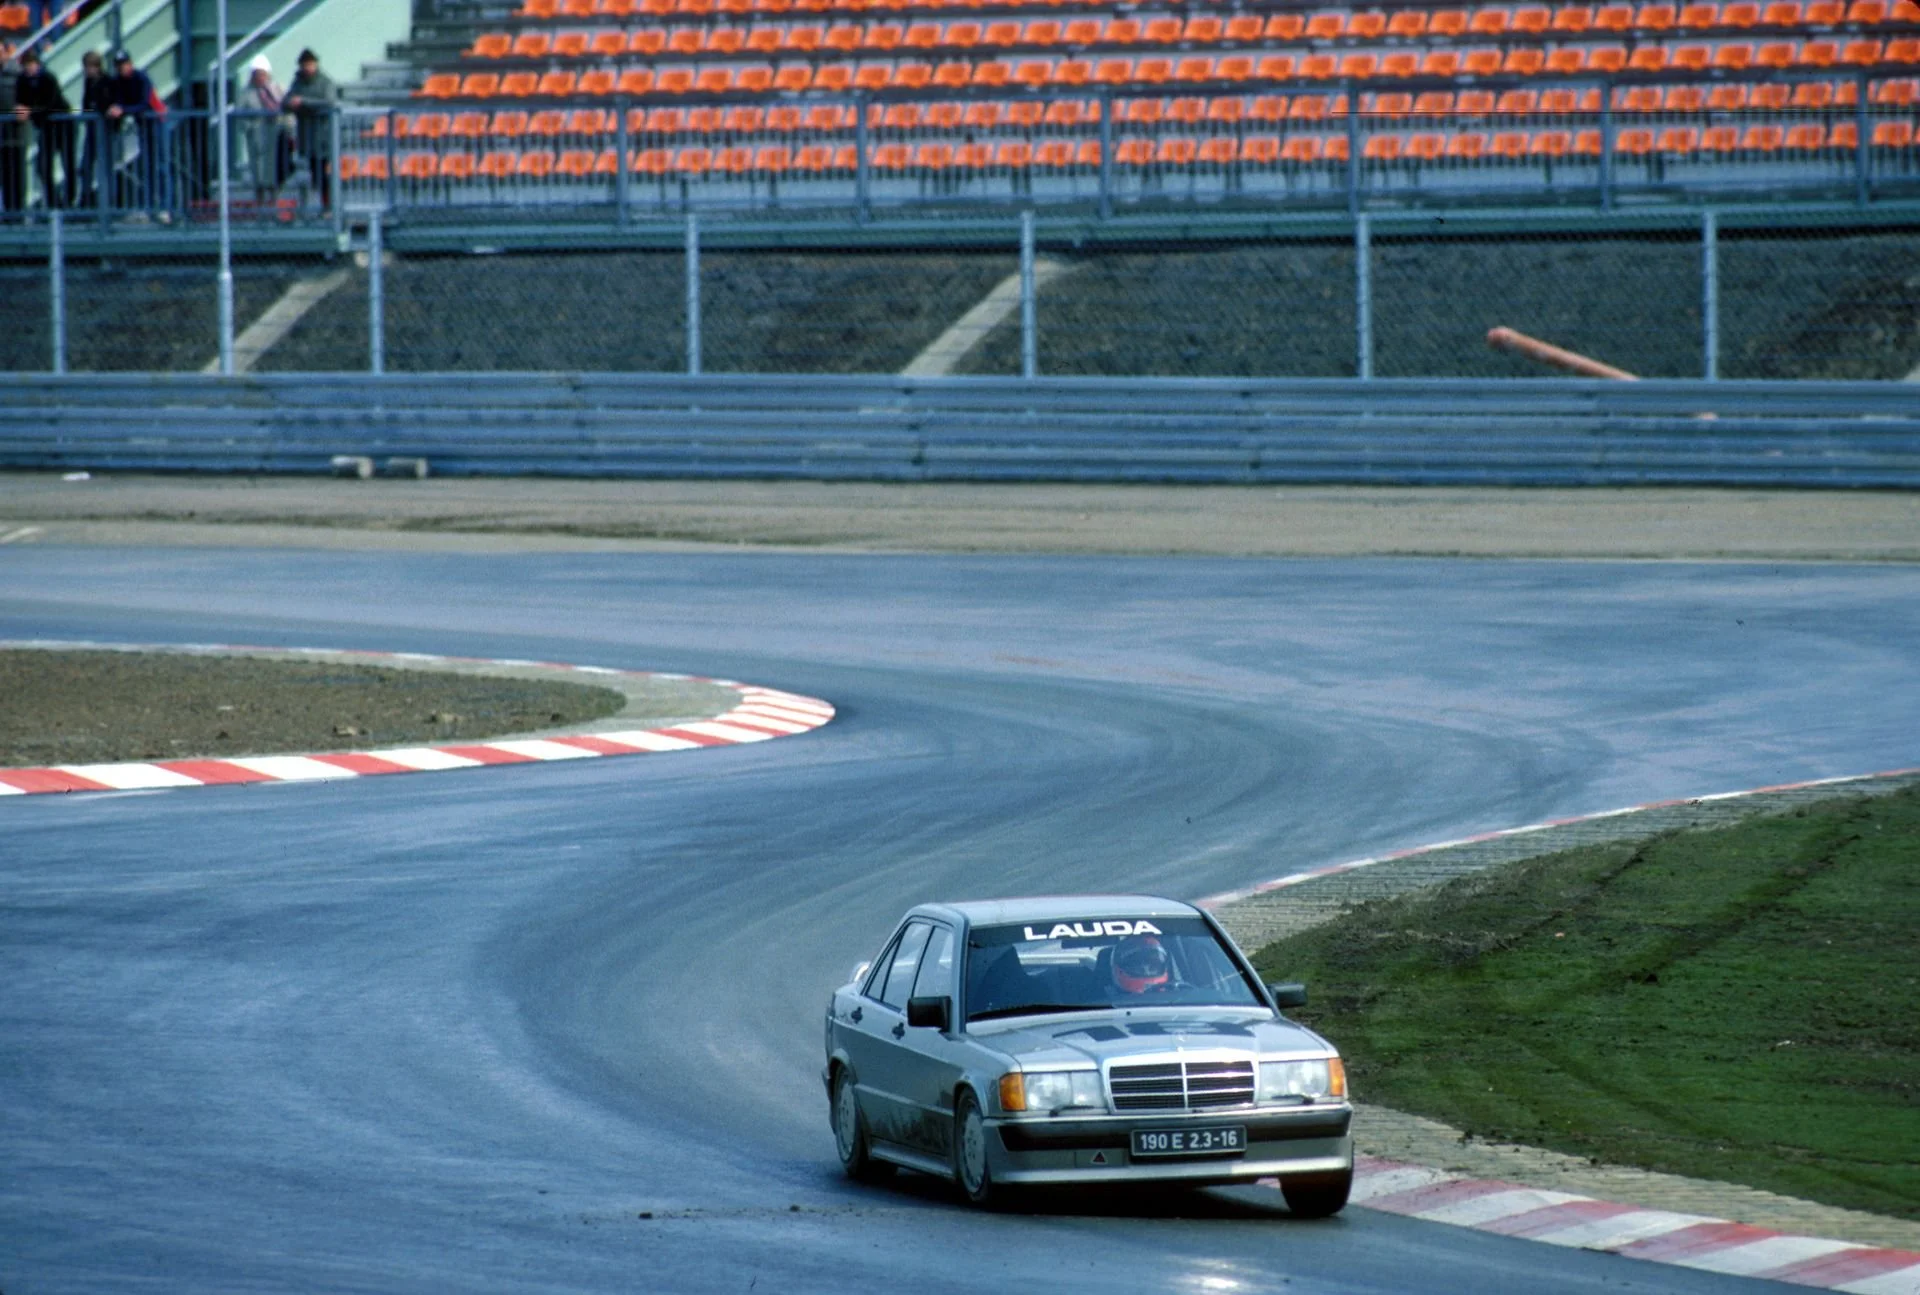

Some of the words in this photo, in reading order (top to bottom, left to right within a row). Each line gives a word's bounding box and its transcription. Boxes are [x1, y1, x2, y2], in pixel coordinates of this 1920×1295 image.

[1024, 920, 1162, 941] LAUDA
[1140, 1133, 1168, 1150] 190
[1171, 1133, 1184, 1149] E
[1189, 1131, 1238, 1149] 2.3-16
